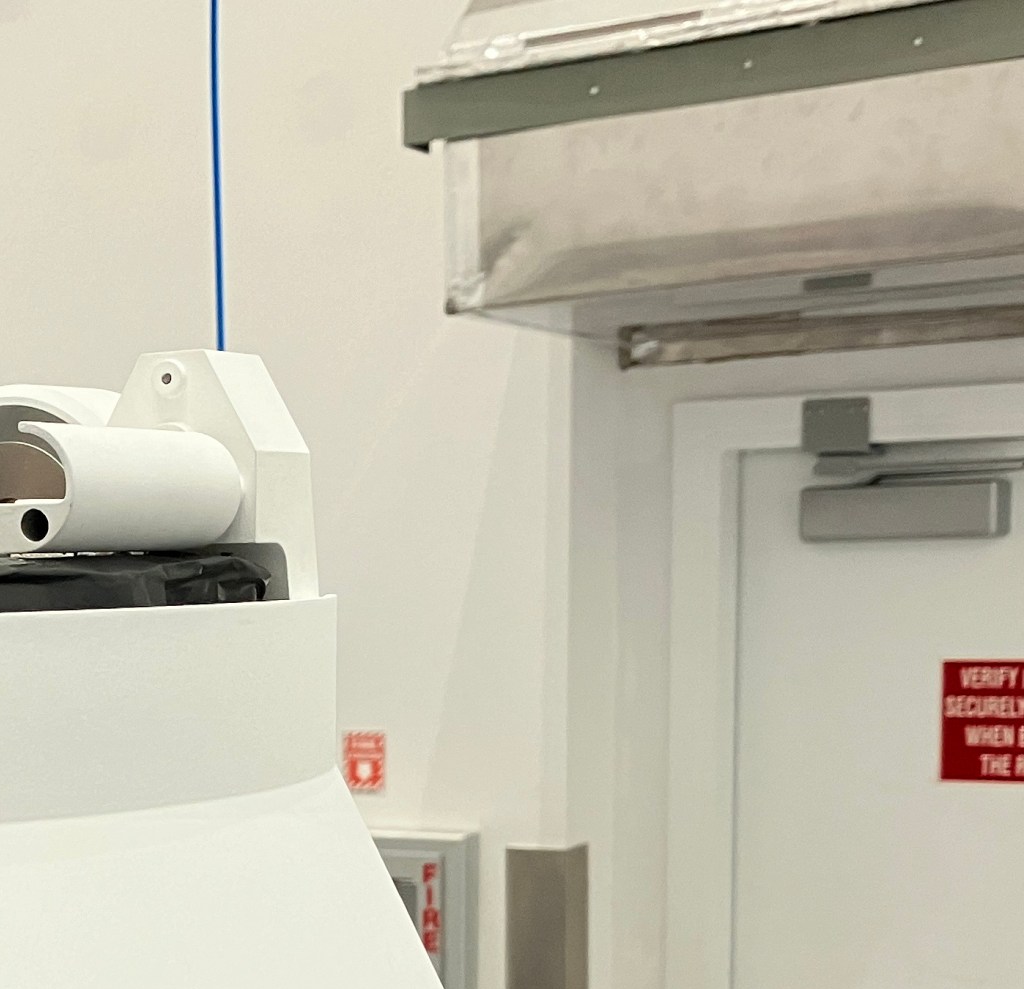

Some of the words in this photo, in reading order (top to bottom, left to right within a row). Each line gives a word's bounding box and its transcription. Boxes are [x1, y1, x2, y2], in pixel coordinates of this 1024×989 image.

[959, 666, 1019, 689] VERIFY
[964, 724, 1015, 748] WHEN
[979, 753, 1013, 777] THE
[422, 862, 441, 954] FIRE
